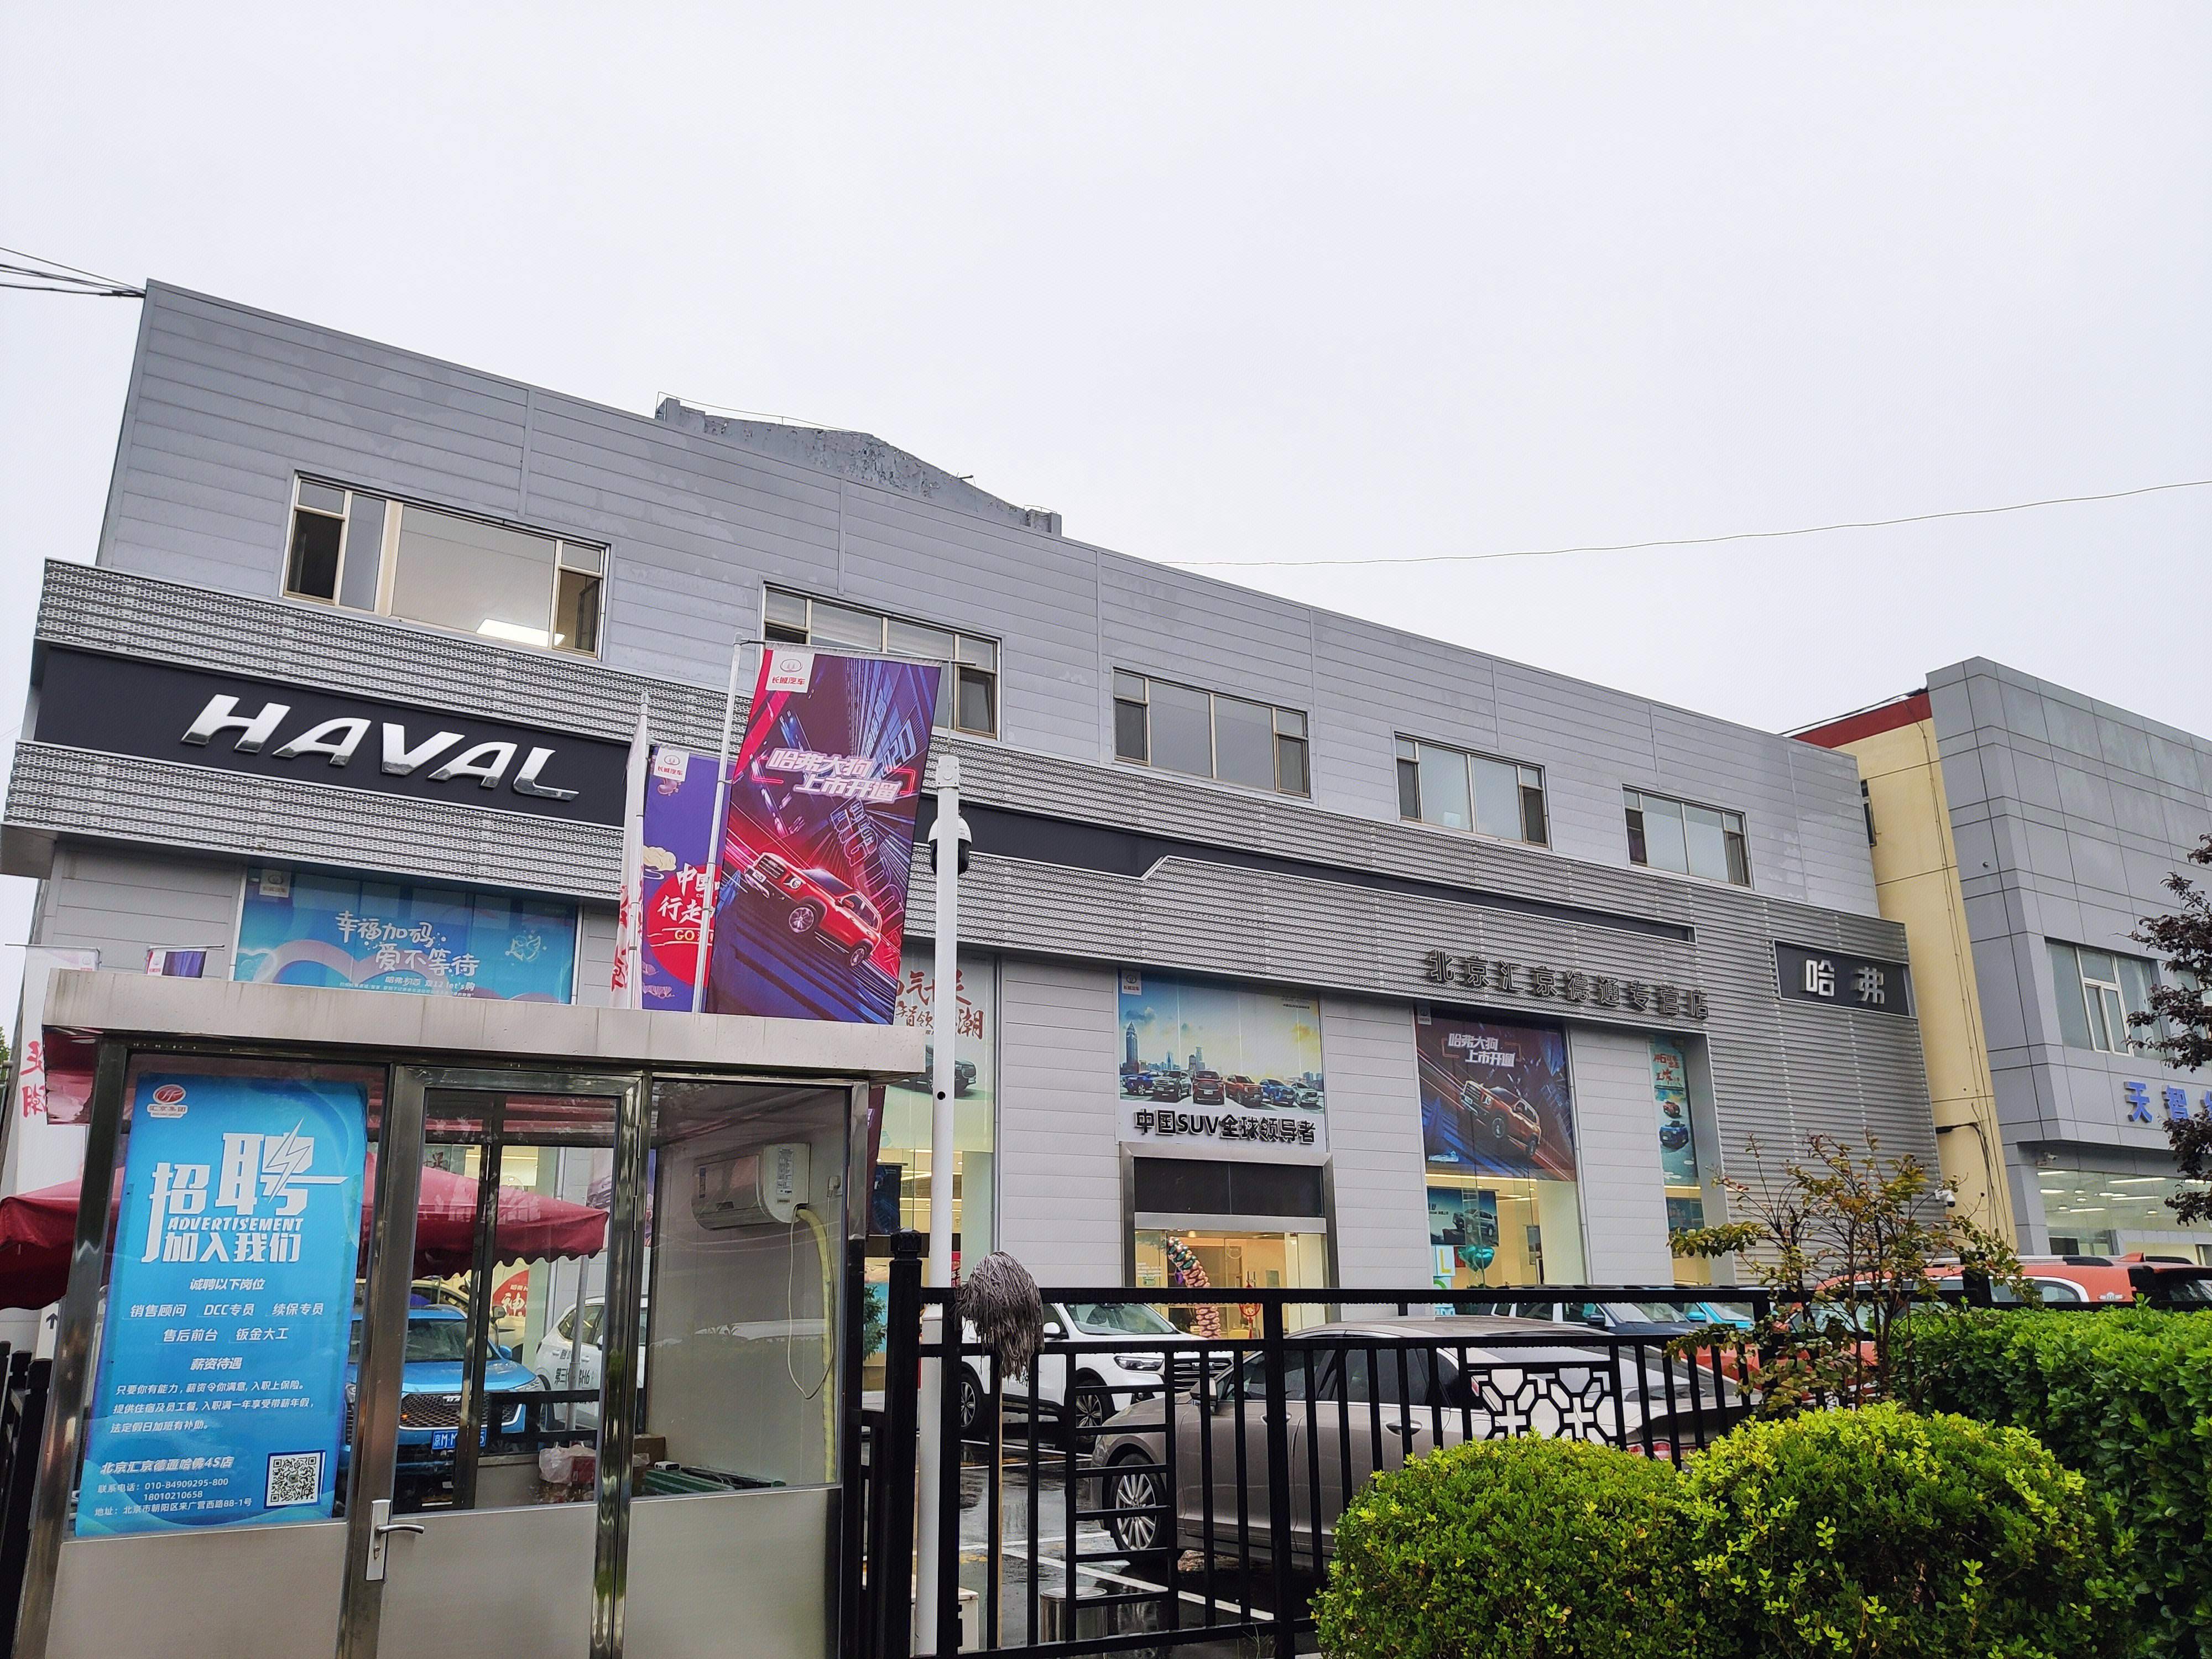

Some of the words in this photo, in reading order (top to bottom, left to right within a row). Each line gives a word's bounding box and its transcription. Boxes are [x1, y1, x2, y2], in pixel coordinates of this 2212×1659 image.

[772, 676, 805, 685] 长城汽车
[180, 694, 579, 801] HAVAL
[768, 748, 874, 778] 哈弗大狗
[676, 863, 720, 896] 中国
[335, 910, 434, 948] 幸福加码
[675, 930, 695, 941] GO
[375, 942, 480, 977] 爱不等待
[1429, 950, 1709, 1020] 北京汇京德通专营店
[1806, 958, 1885, 1004] 哈弗
[1448, 1033, 1498, 1051] 哈弗大狗
[1134, 1108, 1316, 1145] 中国SUV全球领导者
[142, 1118, 348, 1263] 招聘
[168, 1217, 304, 1232] ADVERTISEMENT
[163, 1232, 301, 1263] 加入我们
[190, 1278, 265, 1291] 诚聘以下岗位
[130, 1304, 186, 1318] 销售顾问
[204, 1303, 254, 1316] DCC专员
[272, 1302, 324, 1316] 续保专员
[163, 1328, 218, 1342] 售后前台
[236, 1327, 289, 1341] 钣金大工
[190, 1358, 242, 1371] 薪资待遇
[143, 1491, 203, 1501] 18010210658
